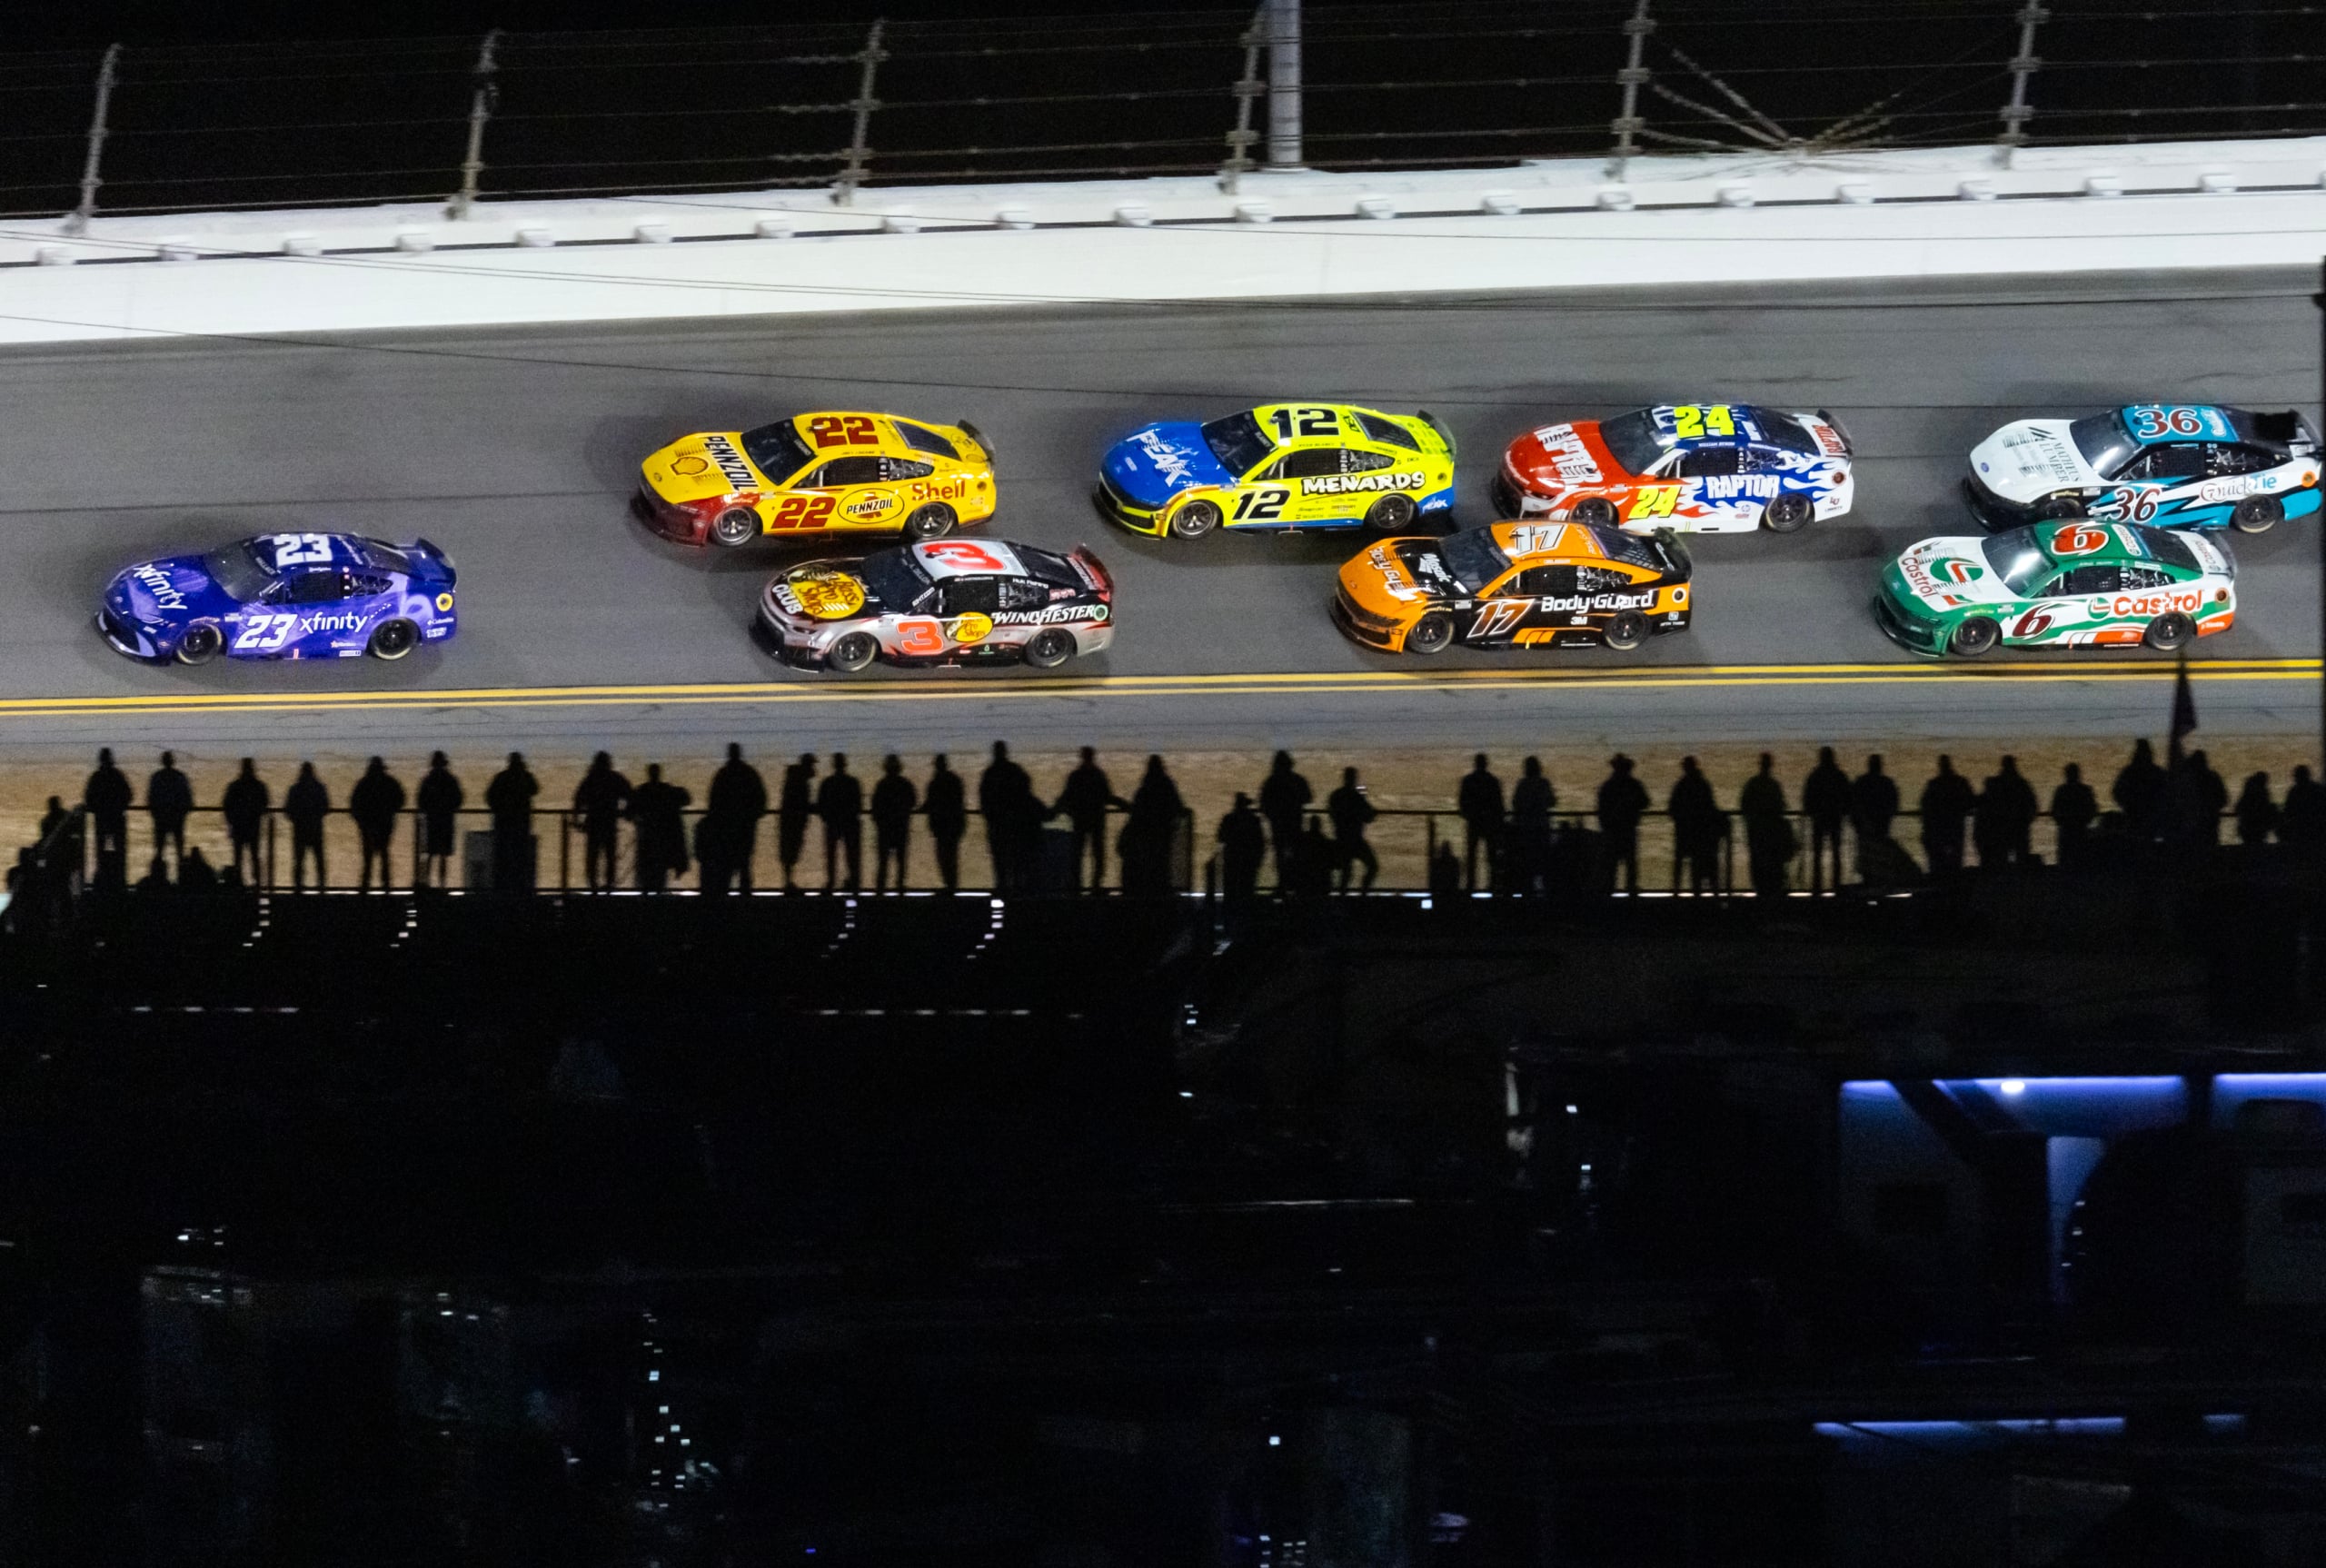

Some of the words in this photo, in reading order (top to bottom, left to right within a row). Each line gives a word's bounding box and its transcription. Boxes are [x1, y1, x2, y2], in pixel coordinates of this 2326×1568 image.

[811, 417, 880, 449] 22
[1272, 408, 1340, 440] 12
[1674, 405, 1735, 439] 24
[2134, 408, 2203, 439] 36
[704, 436, 760, 491] PENNZOIL
[1126, 430, 1193, 487] PEAK
[1534, 423, 1604, 485] RAPTOR
[911, 480, 966, 501] Shell
[1301, 471, 1426, 496] MENARDS
[1705, 474, 1780, 499] RAPTOR
[770, 497, 837, 529] 22
[846, 499, 893, 514] PENNZOIL
[1232, 491, 1291, 520] 12
[1628, 486, 1683, 520] 24
[2105, 487, 2162, 523] 36
[273, 534, 333, 568] 23
[1509, 523, 1569, 557] 17
[2051, 521, 2109, 556] 6
[920, 541, 1007, 571] 3
[133, 563, 189, 610] xfinity
[1902, 557, 1940, 598] Castrol
[771, 583, 804, 615] CLUB
[990, 604, 1096, 626] WINCHESTER
[2114, 590, 2202, 616] Castrol
[234, 614, 298, 649] 23
[300, 611, 367, 633] xfinity
[1466, 599, 1536, 638] 17
[1570, 616, 1588, 626] 3M
[2011, 602, 2058, 640] 6
[897, 620, 944, 654] 3
